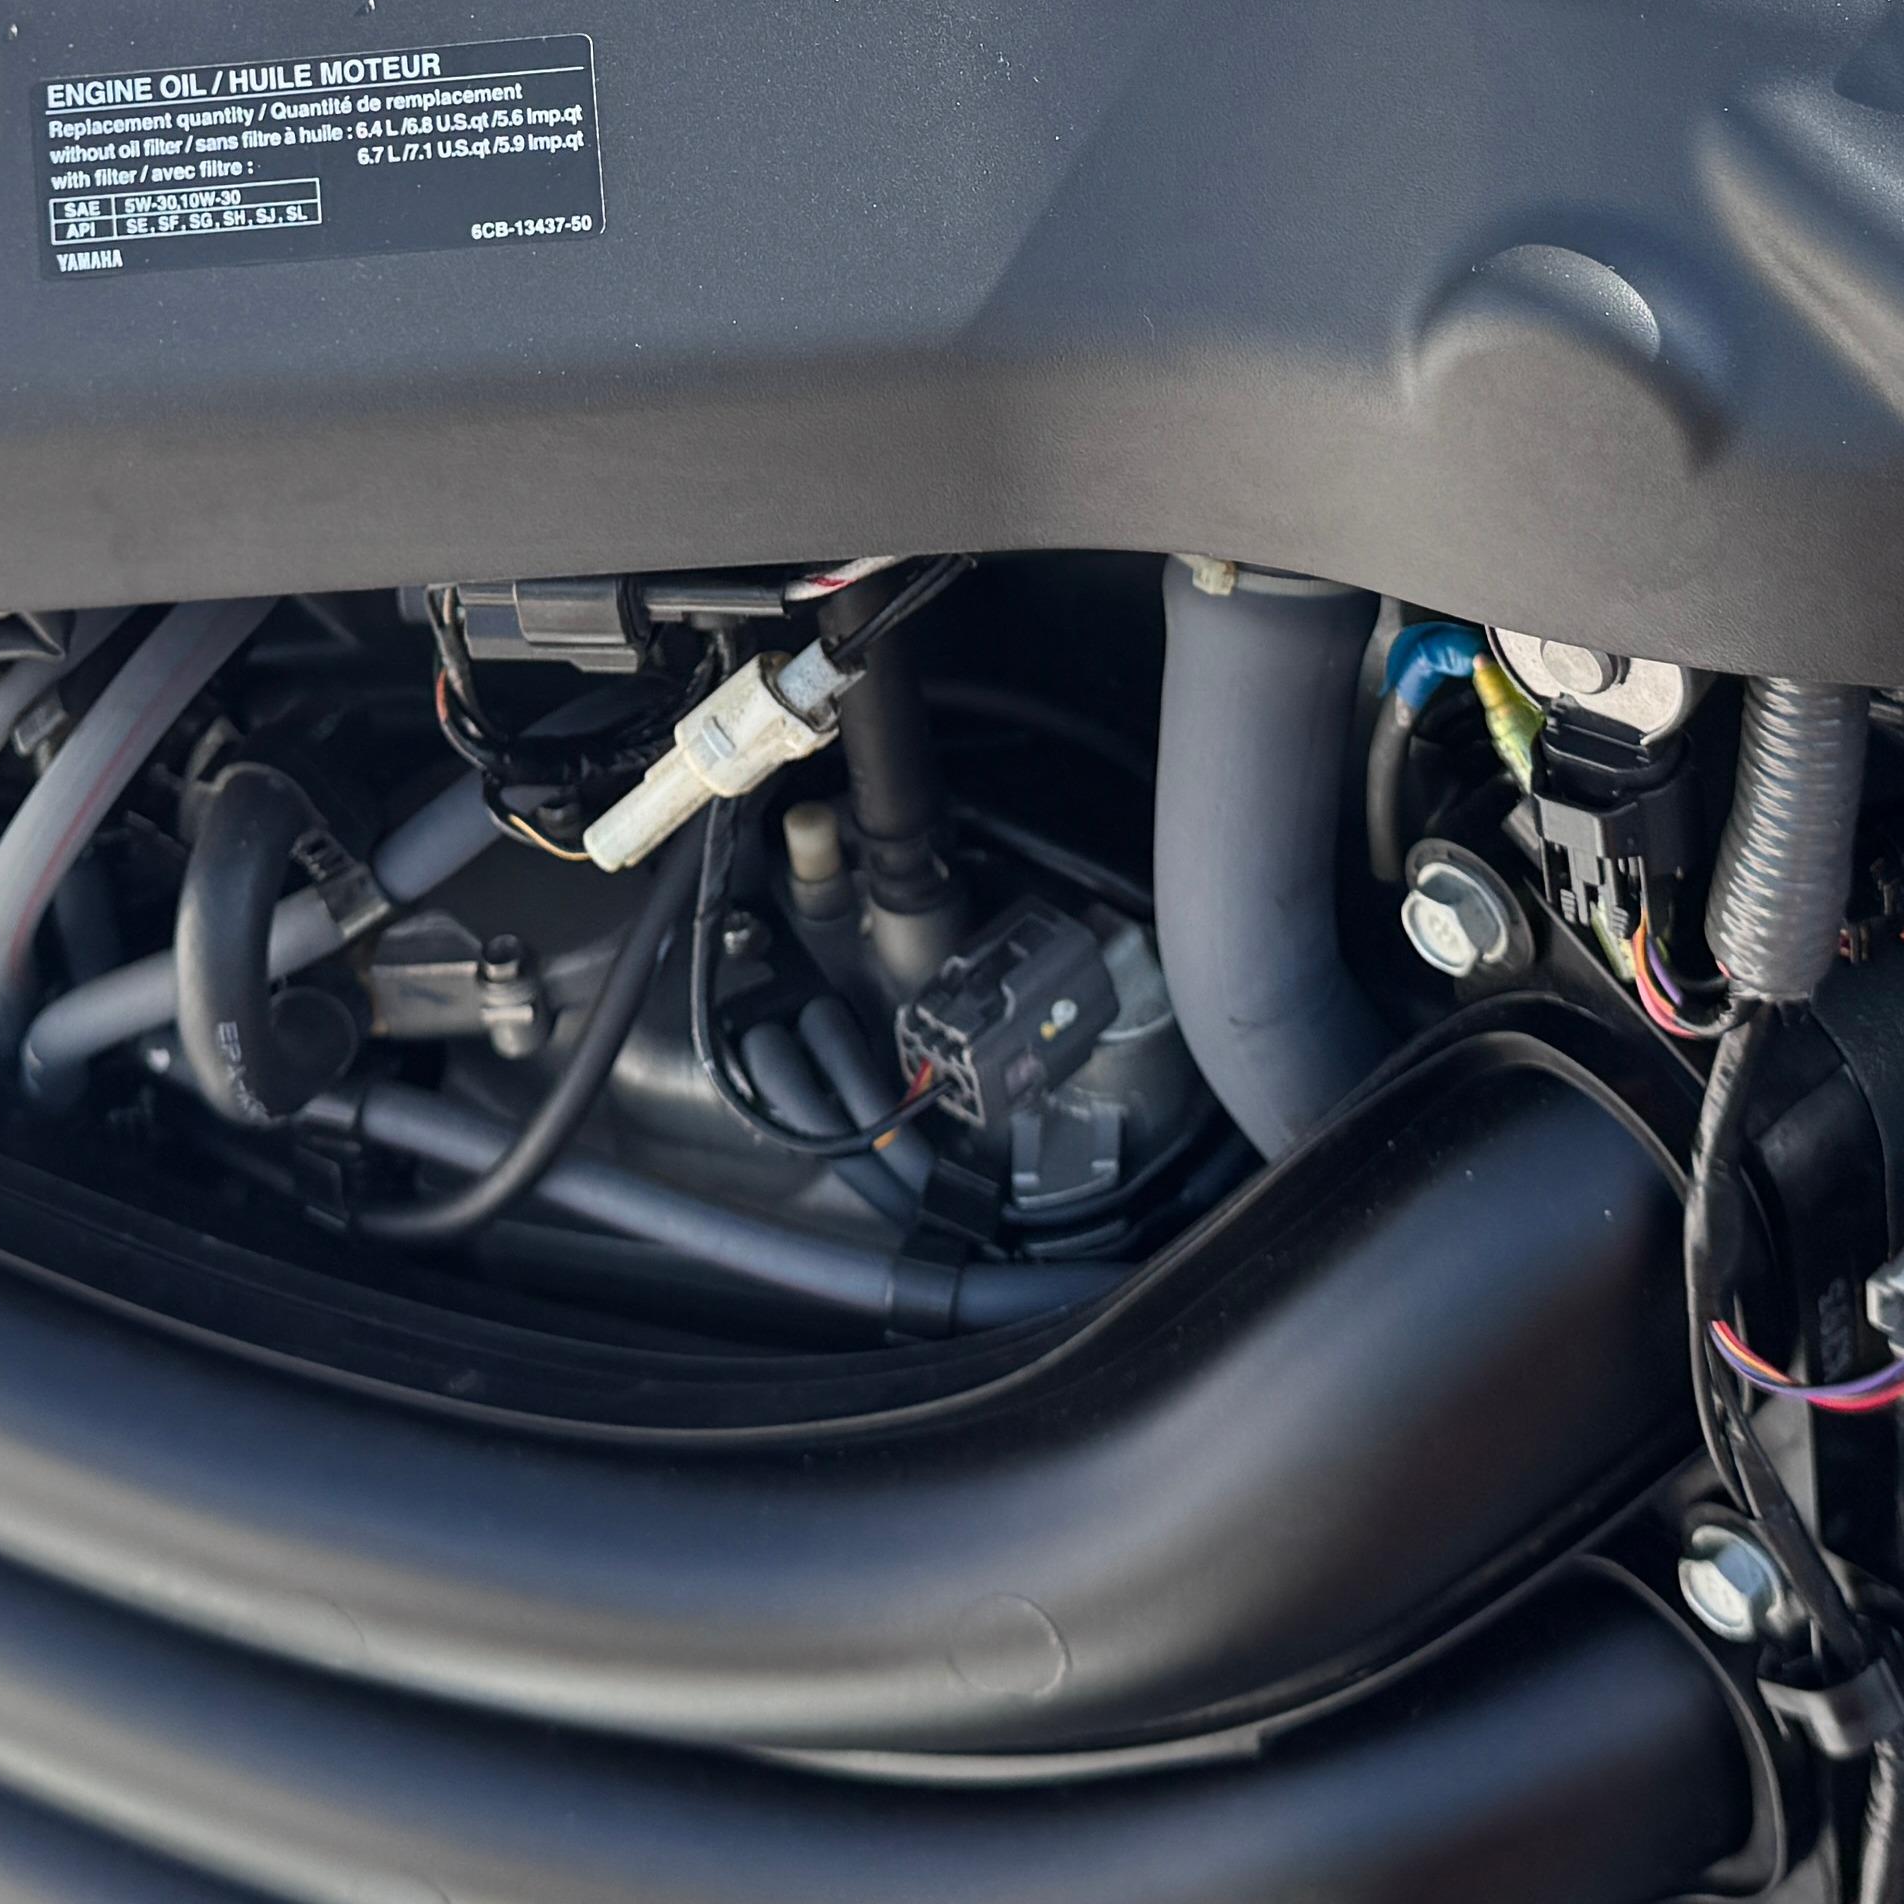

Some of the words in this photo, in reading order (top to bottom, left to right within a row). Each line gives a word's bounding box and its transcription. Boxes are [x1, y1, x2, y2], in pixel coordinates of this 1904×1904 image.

[47, 77, 152, 108] ENGINE
[160, 73, 207, 98] OIL
[230, 64, 312, 93] HUILE
[321, 53, 441, 85] MOTEUR
[49, 113, 172, 140] Replacement
[177, 106, 254, 131] quantity
[271, 98, 352, 120] Quantité
[357, 95, 381, 113] de
[386, 83, 523, 111] remplacement
[49, 143, 116, 164] without
[119, 139, 140, 158] oil
[144, 137, 182, 156] filter
[195, 136, 238, 153] sans
[242, 130, 281, 149] filtre
[284, 128, 296, 144] à
[299, 123, 343, 143] huile
[355, 121, 383, 139] 6.4
[386, 120, 398, 137] L
[436, 113, 489, 132] U.S.qt
[527, 104, 582, 124] Imp.qt
[51, 170, 90, 190] with
[94, 166, 137, 186] filter
[152, 164, 195, 182] avec
[199, 159, 243, 178] filtre
[358, 147, 384, 165] 6.7
[388, 146, 400, 162] L
[437, 139, 491, 159] U.S.qt
[529, 131, 584, 151] Imp.qt
[64, 201, 101, 218] SAE
[125, 189, 241, 212] 5W-30,10W-30
[66, 222, 96, 239] API
[286, 205, 308, 221] SL
[470, 215, 592, 241] 6CB-13437-50
[57, 249, 123, 272] YAMAHA
